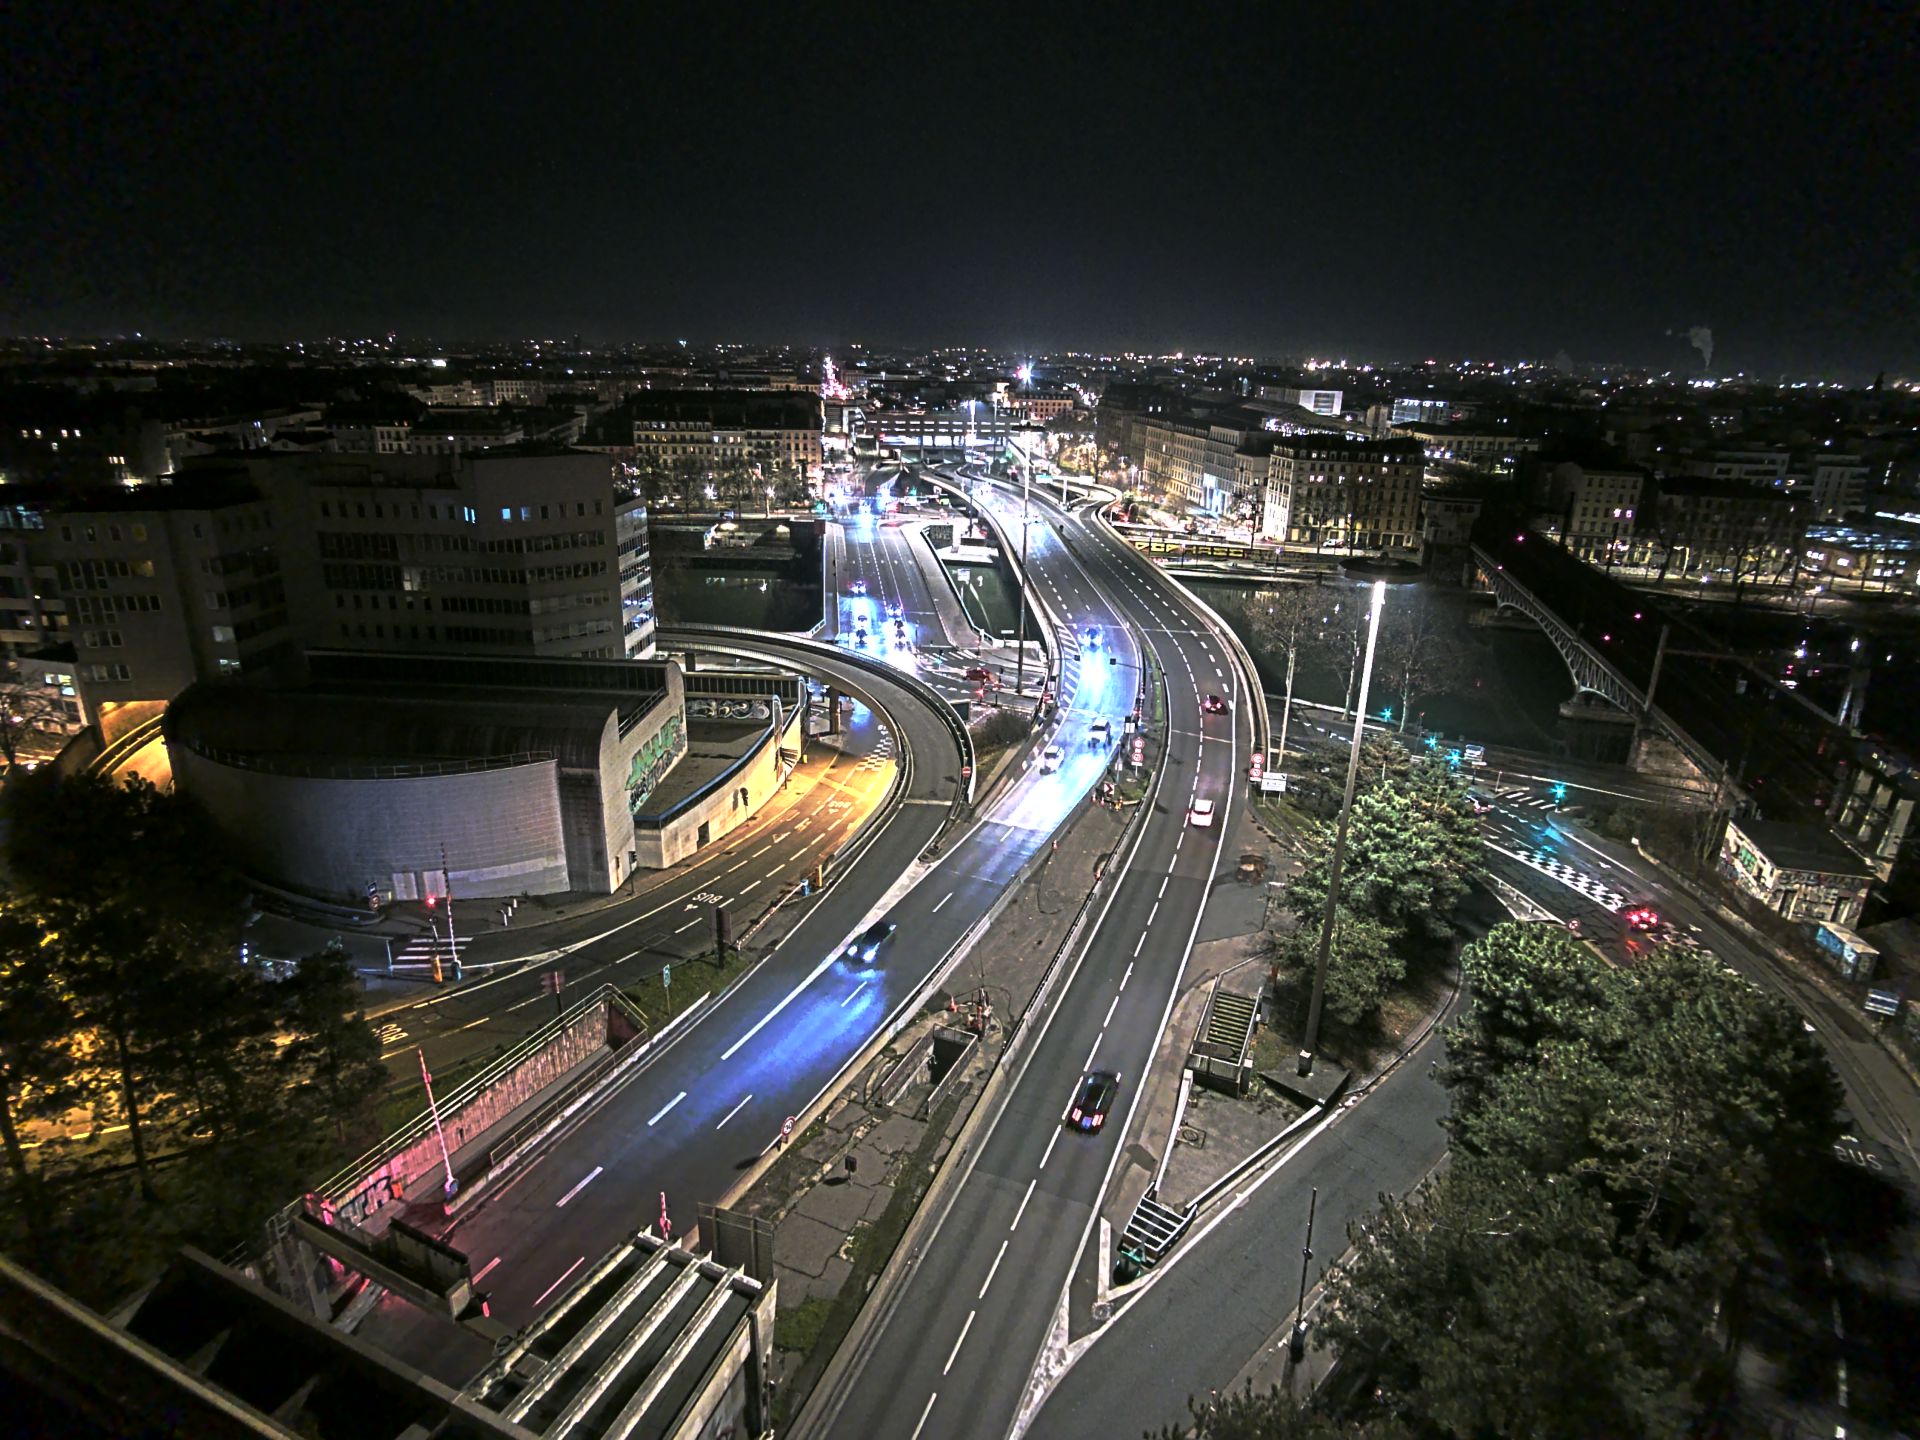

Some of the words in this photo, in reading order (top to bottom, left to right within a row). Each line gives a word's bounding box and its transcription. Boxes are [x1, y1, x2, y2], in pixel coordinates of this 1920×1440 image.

[692, 892, 723, 904] BUS
[380, 1023, 409, 1045] BUS
[1833, 1145, 1883, 1171] BUS
